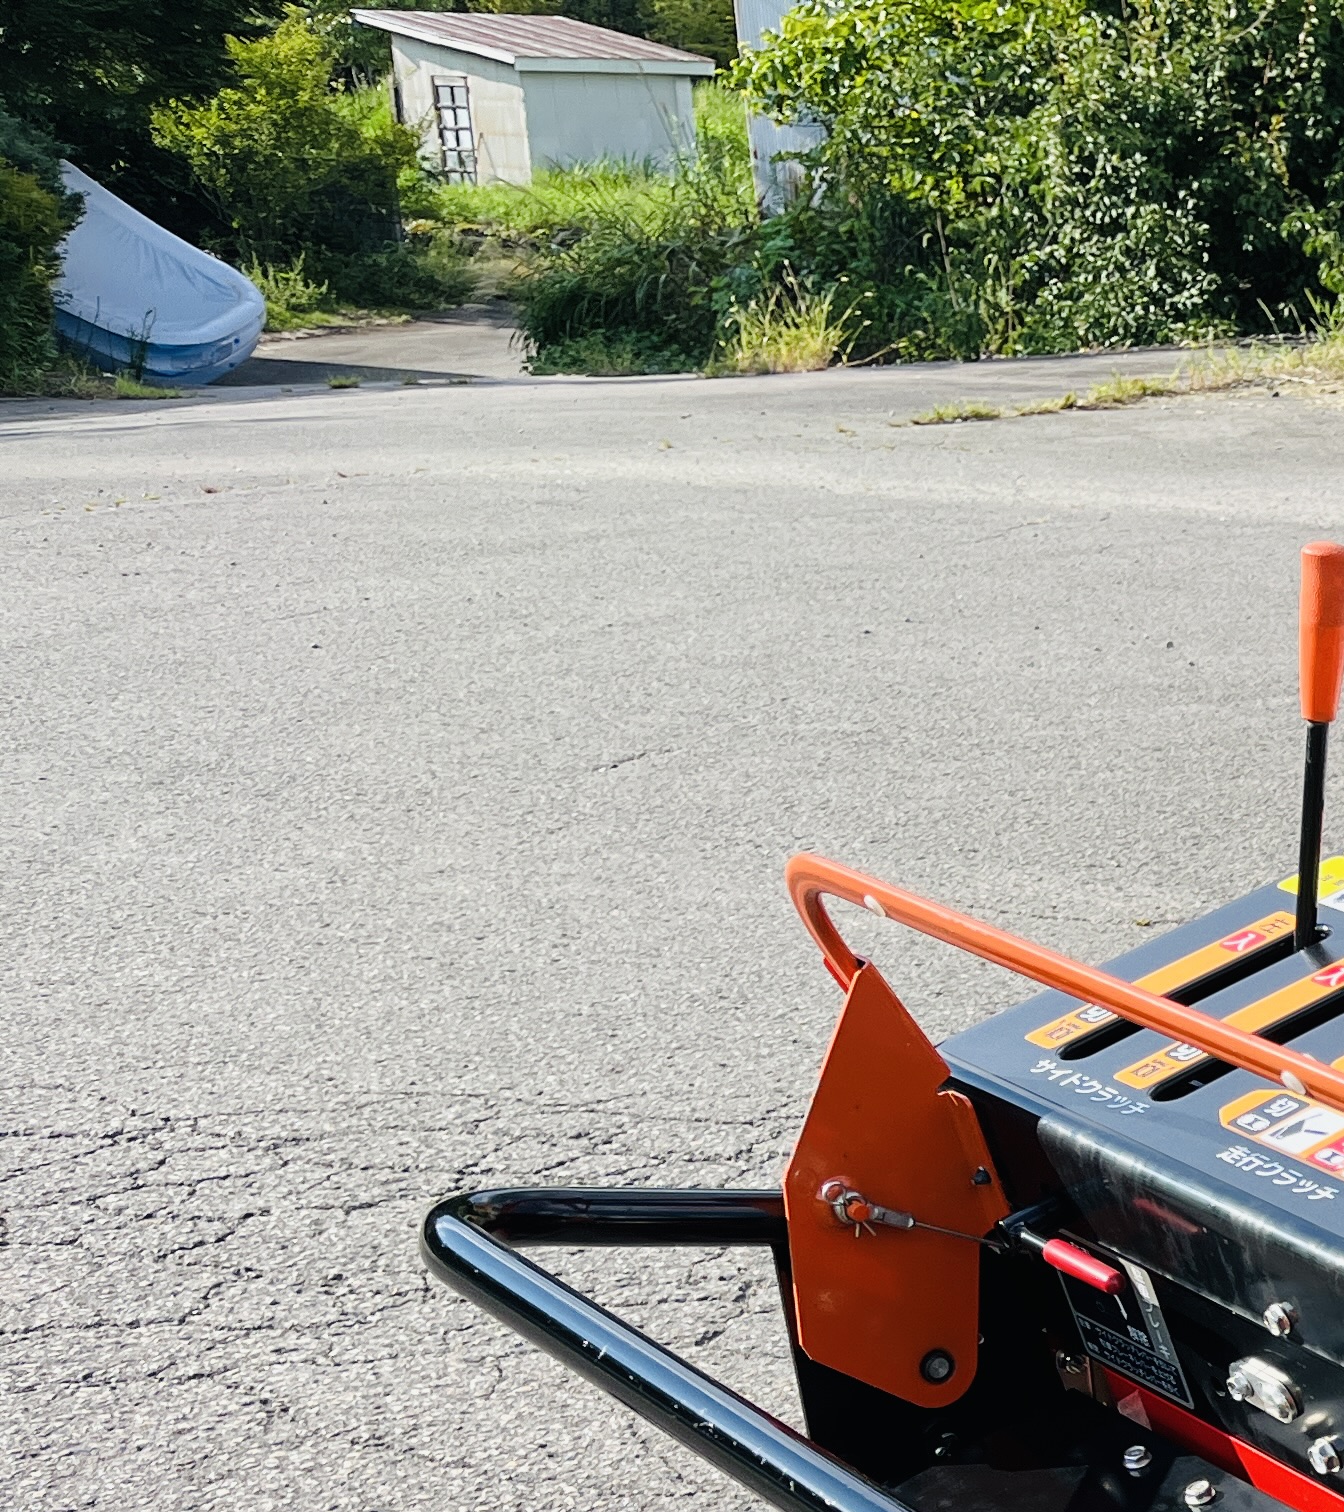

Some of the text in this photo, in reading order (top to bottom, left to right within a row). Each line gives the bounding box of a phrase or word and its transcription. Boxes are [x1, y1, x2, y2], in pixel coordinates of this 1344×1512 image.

[1029, 1059, 1151, 1115] サイドクラッチ
[1264, 1097, 1300, 1118] 切
[1215, 1144, 1340, 1200] 走行クラッチ
